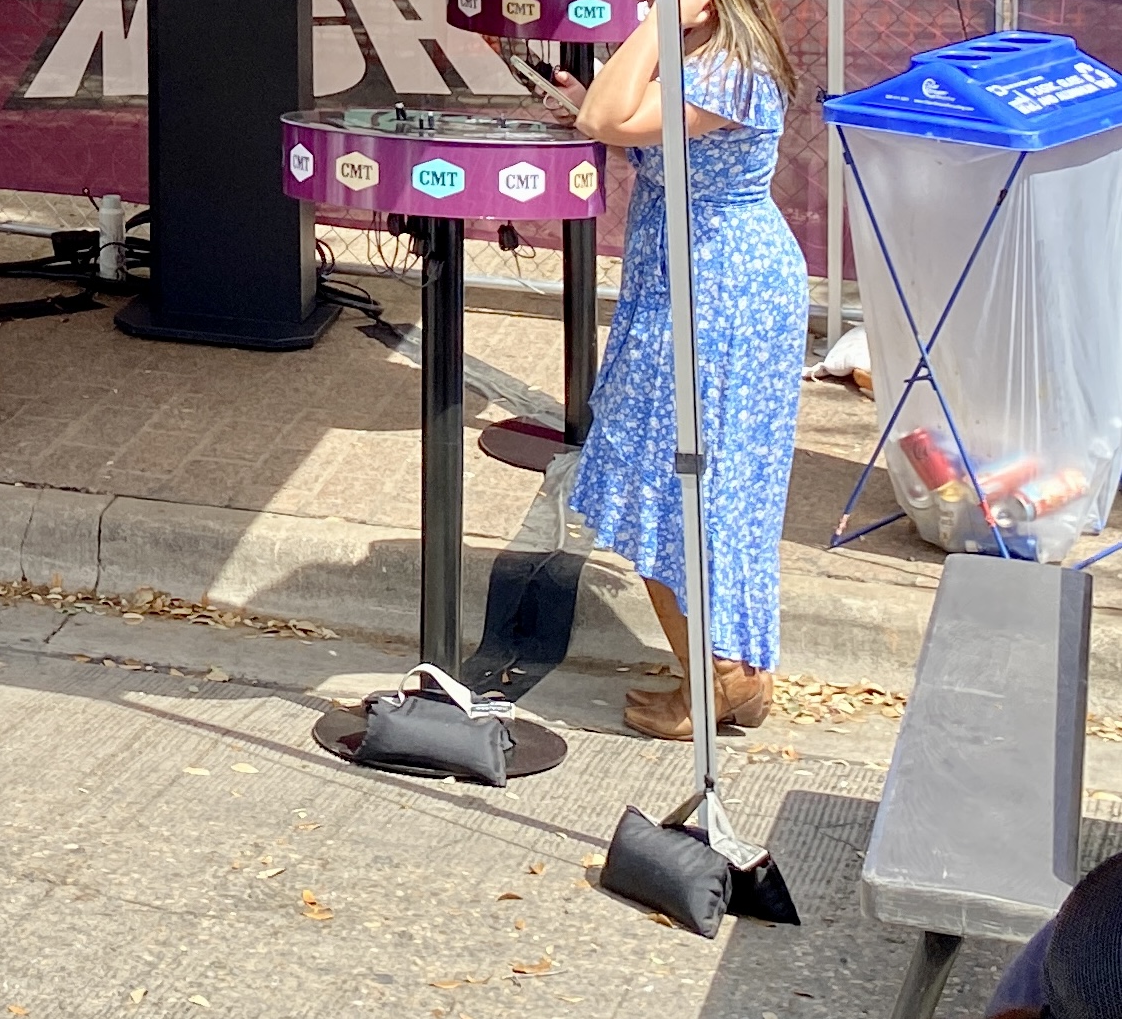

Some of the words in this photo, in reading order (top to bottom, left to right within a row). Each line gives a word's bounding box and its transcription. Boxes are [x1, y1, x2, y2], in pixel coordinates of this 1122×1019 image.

[506, 2, 536, 16] CMT
[573, 5, 606, 19] CMT
[292, 155, 310, 171] CMT
[340, 165, 373, 180] CMT
[419, 170, 458, 187] CMT
[573, 172, 594, 189] CMT
[505, 174, 540, 190] CMT
